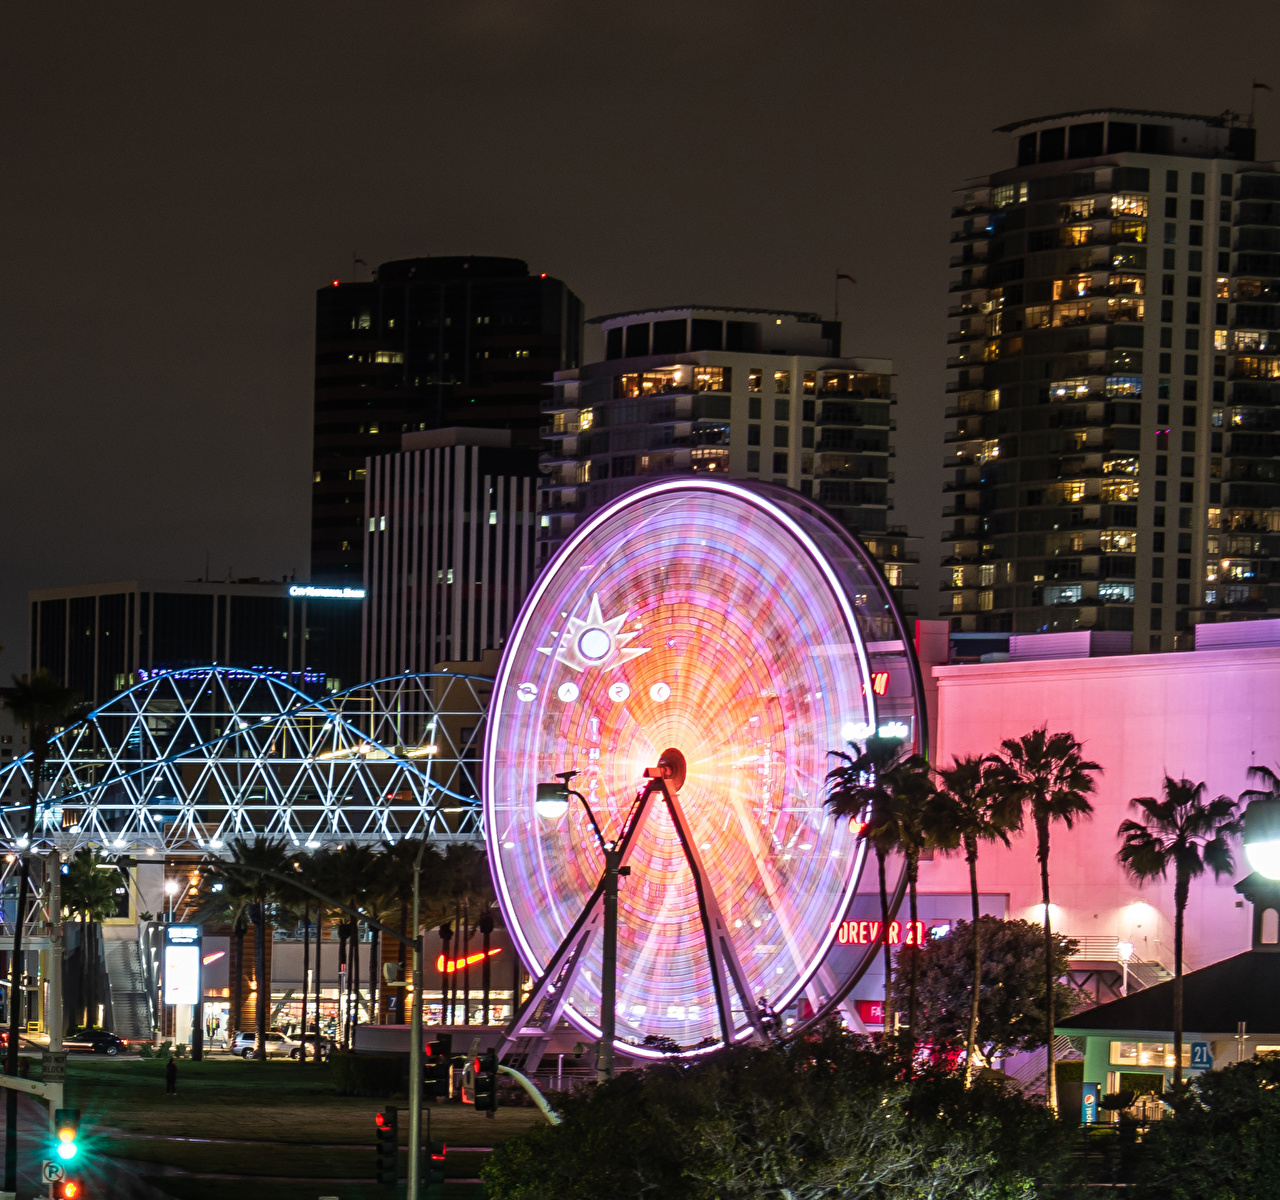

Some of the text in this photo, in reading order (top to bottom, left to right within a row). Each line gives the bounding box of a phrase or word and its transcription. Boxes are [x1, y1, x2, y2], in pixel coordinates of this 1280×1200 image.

[830, 920, 900, 945] OREVR
[906, 920, 924, 945] 21
[1194, 1046, 1207, 1062] 21
